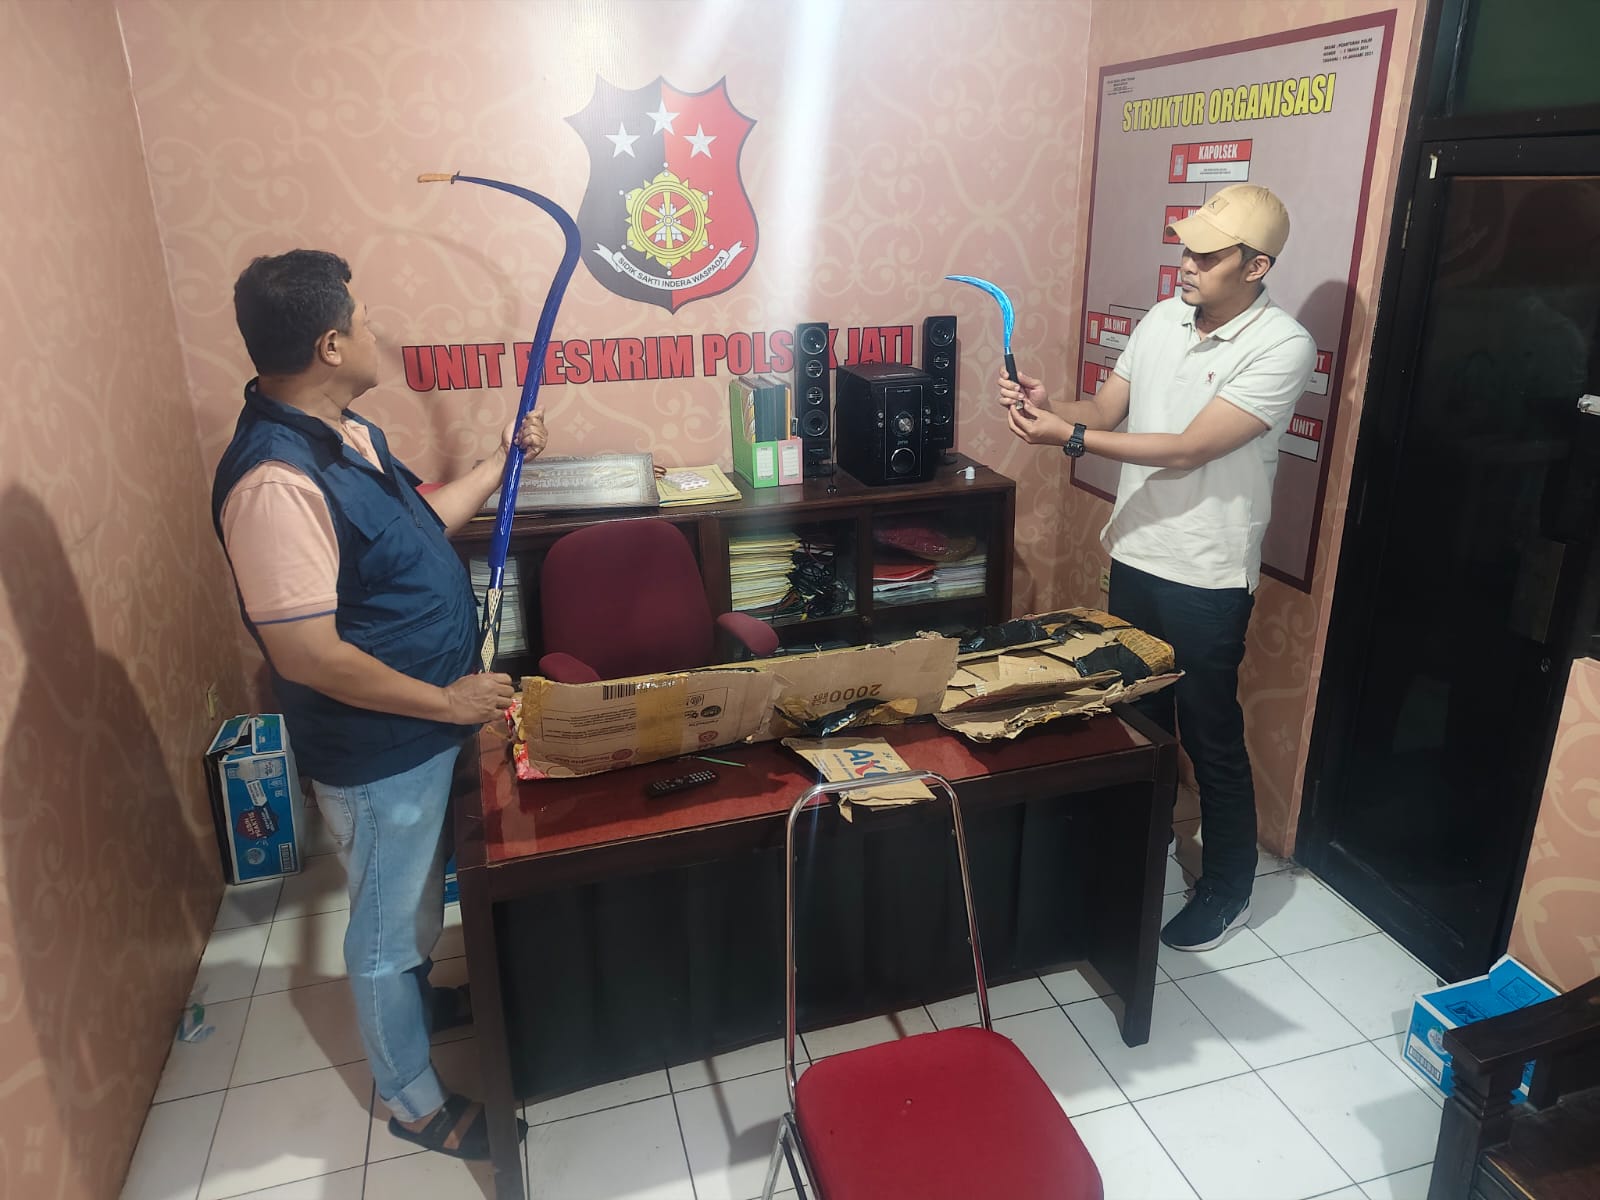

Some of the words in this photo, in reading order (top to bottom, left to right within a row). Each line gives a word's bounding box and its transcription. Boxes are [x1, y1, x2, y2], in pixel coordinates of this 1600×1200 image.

[1122, 92, 1205, 132] STRUKTUR
[1208, 72, 1337, 125] ORGANISASI
[1198, 143, 1239, 160] KAPOLSEK
[618, 257, 637, 276] SIDIK
[637, 272, 661, 286] SAKTI
[662, 278, 692, 288] INDERA
[692, 255, 725, 283] WASPADA
[401, 343, 506, 393] UNIT
[513, 335, 695, 387] RESKRIM
[702, 328, 839, 377] POLSK
[844, 325, 914, 366] JATI
[1292, 417, 1316, 438] UNIT
[829, 683, 883, 703] 2000
